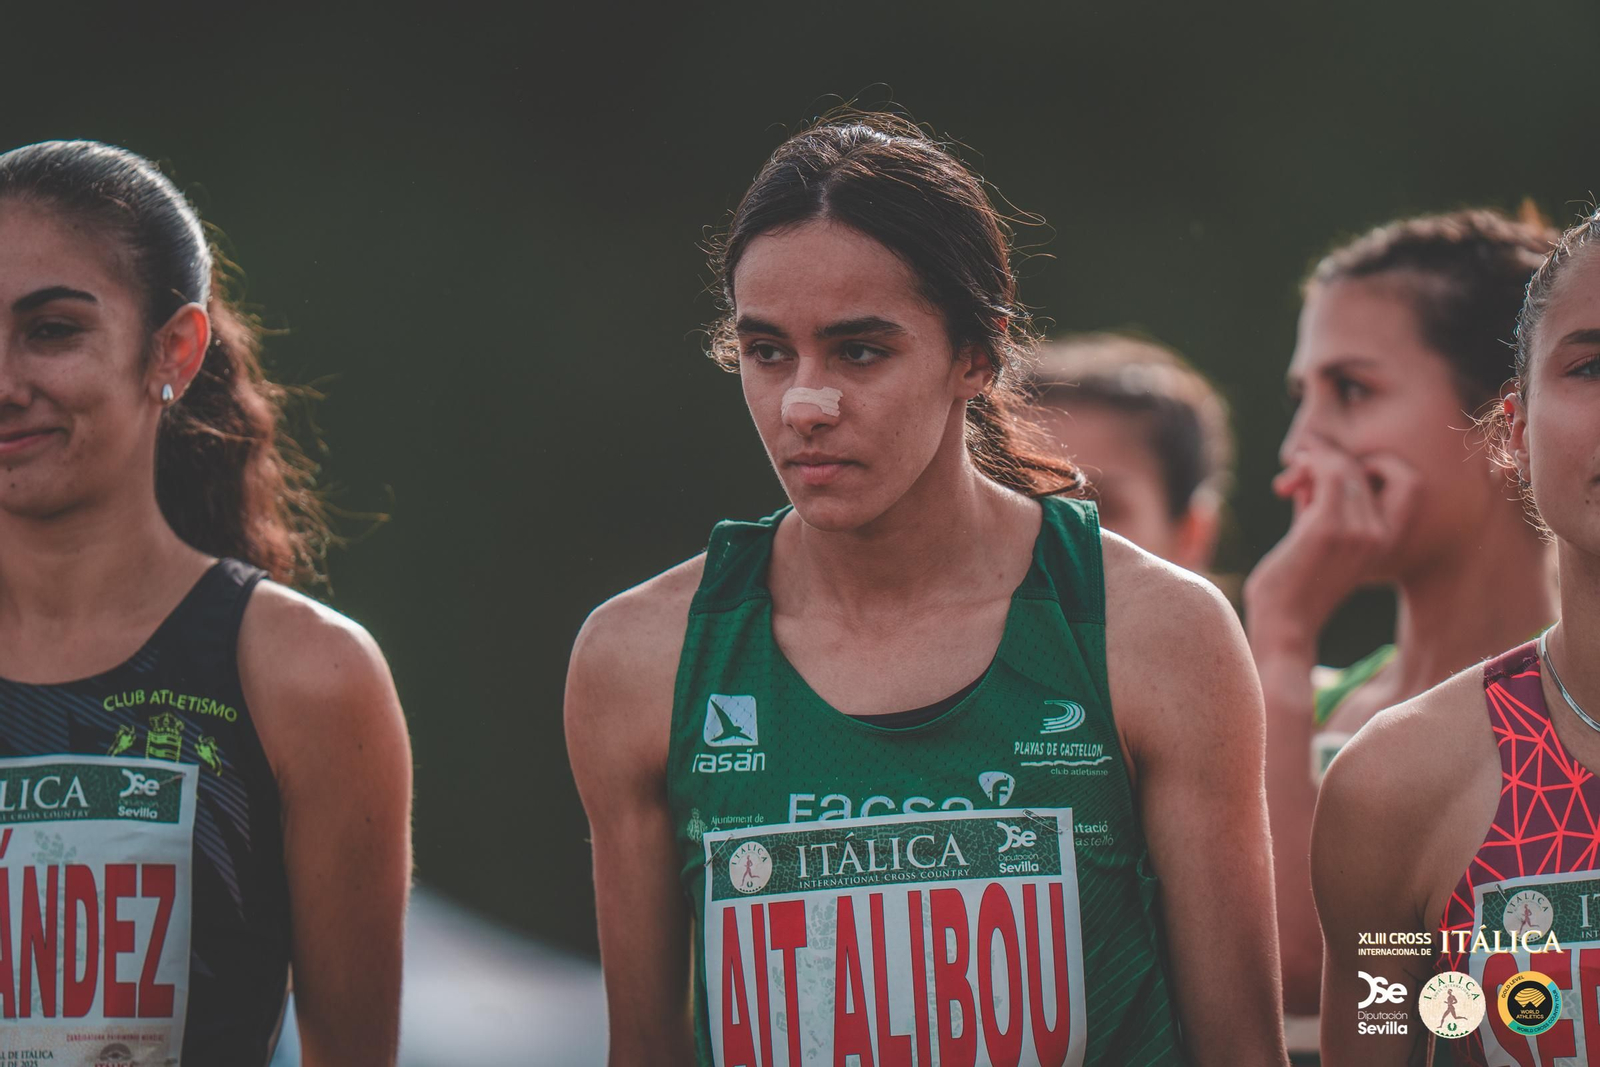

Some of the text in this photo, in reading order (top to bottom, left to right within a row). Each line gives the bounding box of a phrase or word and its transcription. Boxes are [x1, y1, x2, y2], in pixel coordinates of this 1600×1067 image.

[103, 689, 238, 722] CLUB ATLETISMO
[1014, 741, 1103, 757] PLAYAS DE CASTELLON
[1070, 768, 1109, 776] atletismo
[43, 810, 90, 819] COUNTRY
[118, 806, 158, 819] Sevilla
[754, 814, 764, 823] de
[1074, 820, 1109, 833] tació
[1075, 834, 1114, 847] astelló
[796, 831, 970, 878] ITÁLICA
[999, 861, 1039, 874] Sevilla
[800, 869, 971, 889] INTERNATIONAL CROSS COUNTRY
[723, 882, 1071, 1067] AIT ALIBOU
[1482, 948, 1600, 1067] SE
[8, 1051, 19, 1060] DE
[21, 1047, 54, 1060] ITÁLICA
